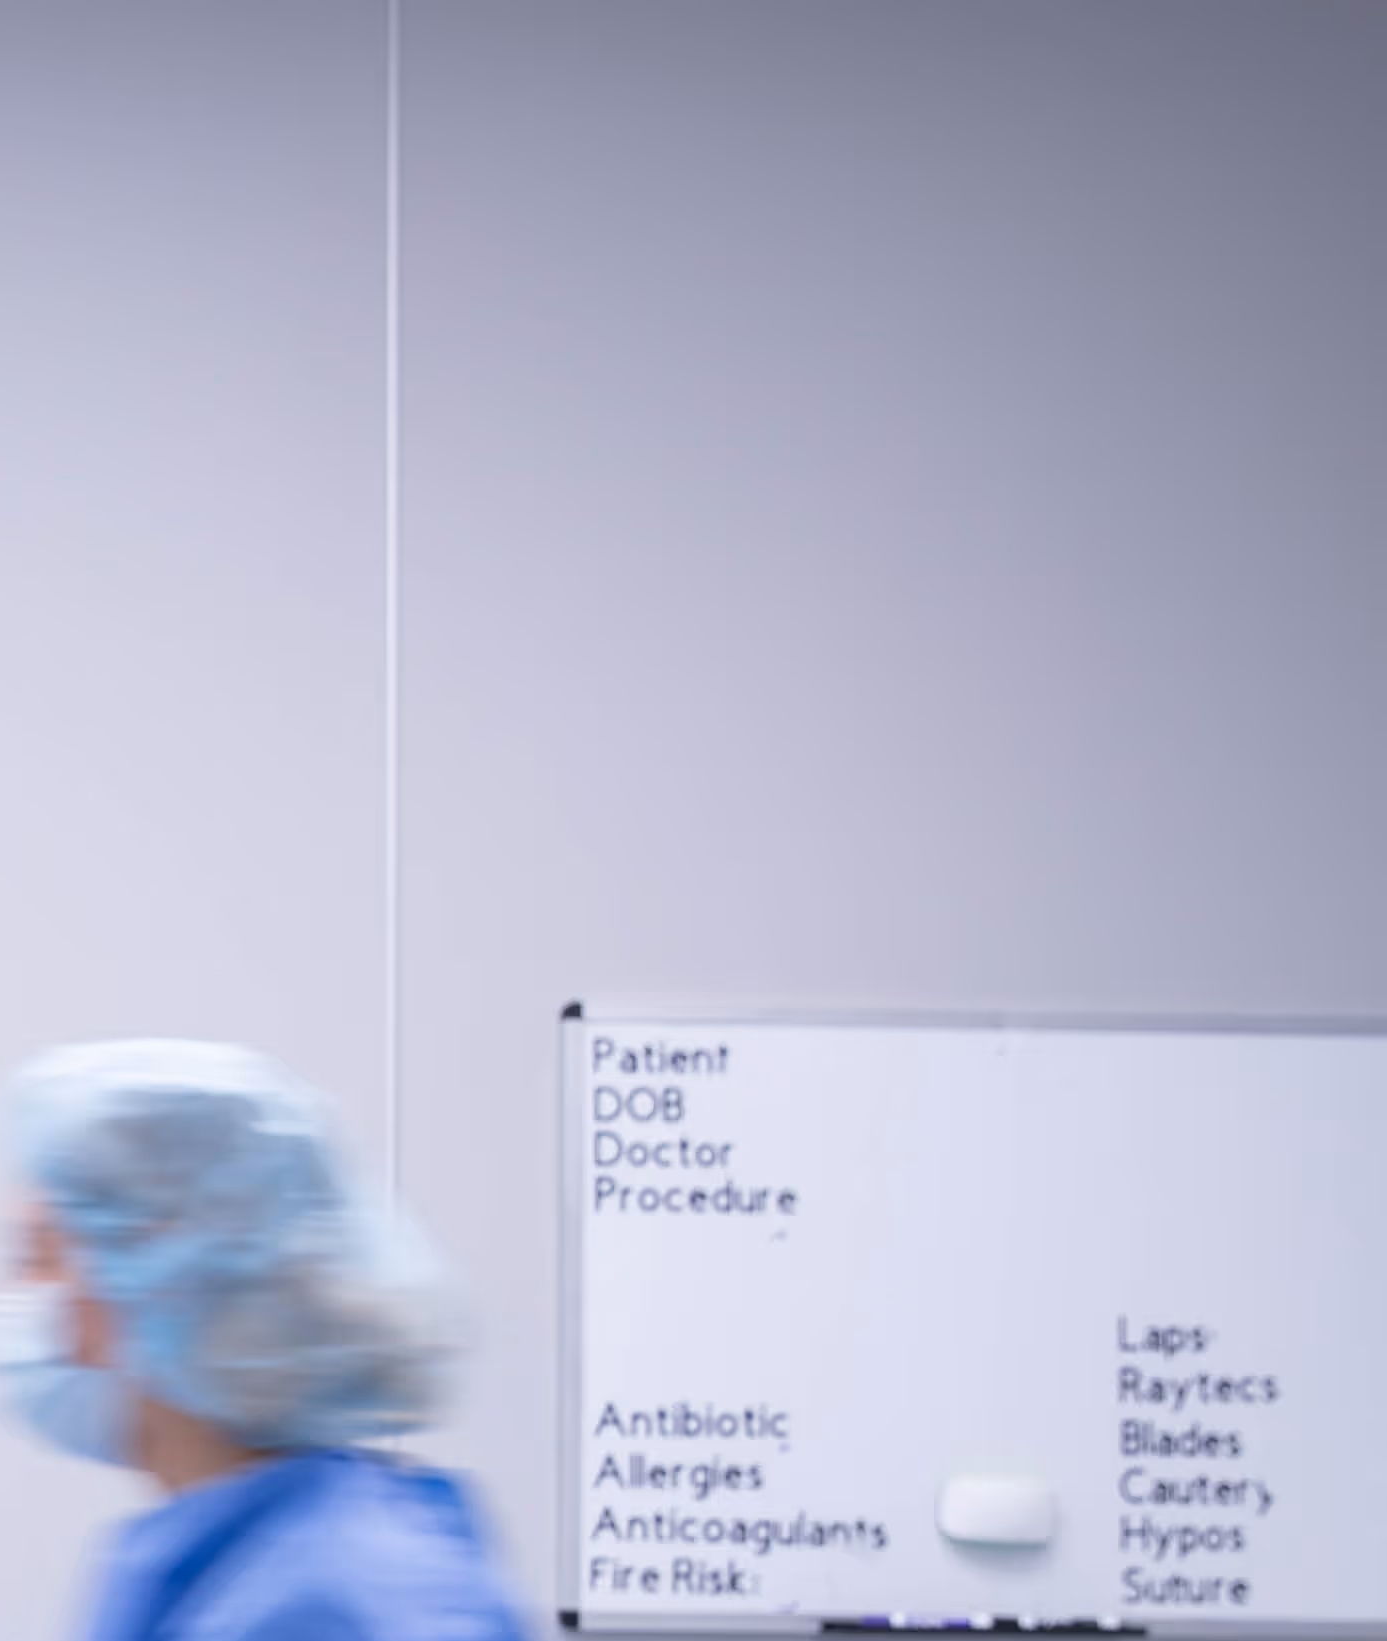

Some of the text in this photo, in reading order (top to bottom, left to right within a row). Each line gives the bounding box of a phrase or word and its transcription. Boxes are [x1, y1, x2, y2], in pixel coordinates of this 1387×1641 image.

[593, 1037, 729, 1074] Patient
[593, 1086, 685, 1124] DOB
[594, 1130, 732, 1168] Doctor
[594, 1175, 798, 1214] Procedure
[1117, 1315, 1207, 1358] Laps
[1118, 1365, 1279, 1412] Raytecs
[595, 1402, 787, 1438] Antibiotic
[1120, 1418, 1242, 1458] Blades
[594, 1454, 764, 1501] Allergies
[591, 1506, 889, 1554] Anticoagulants
[1119, 1515, 1246, 1560] Hypos
[589, 1557, 661, 1594] Fire
[1122, 1566, 1250, 1605] Suture
